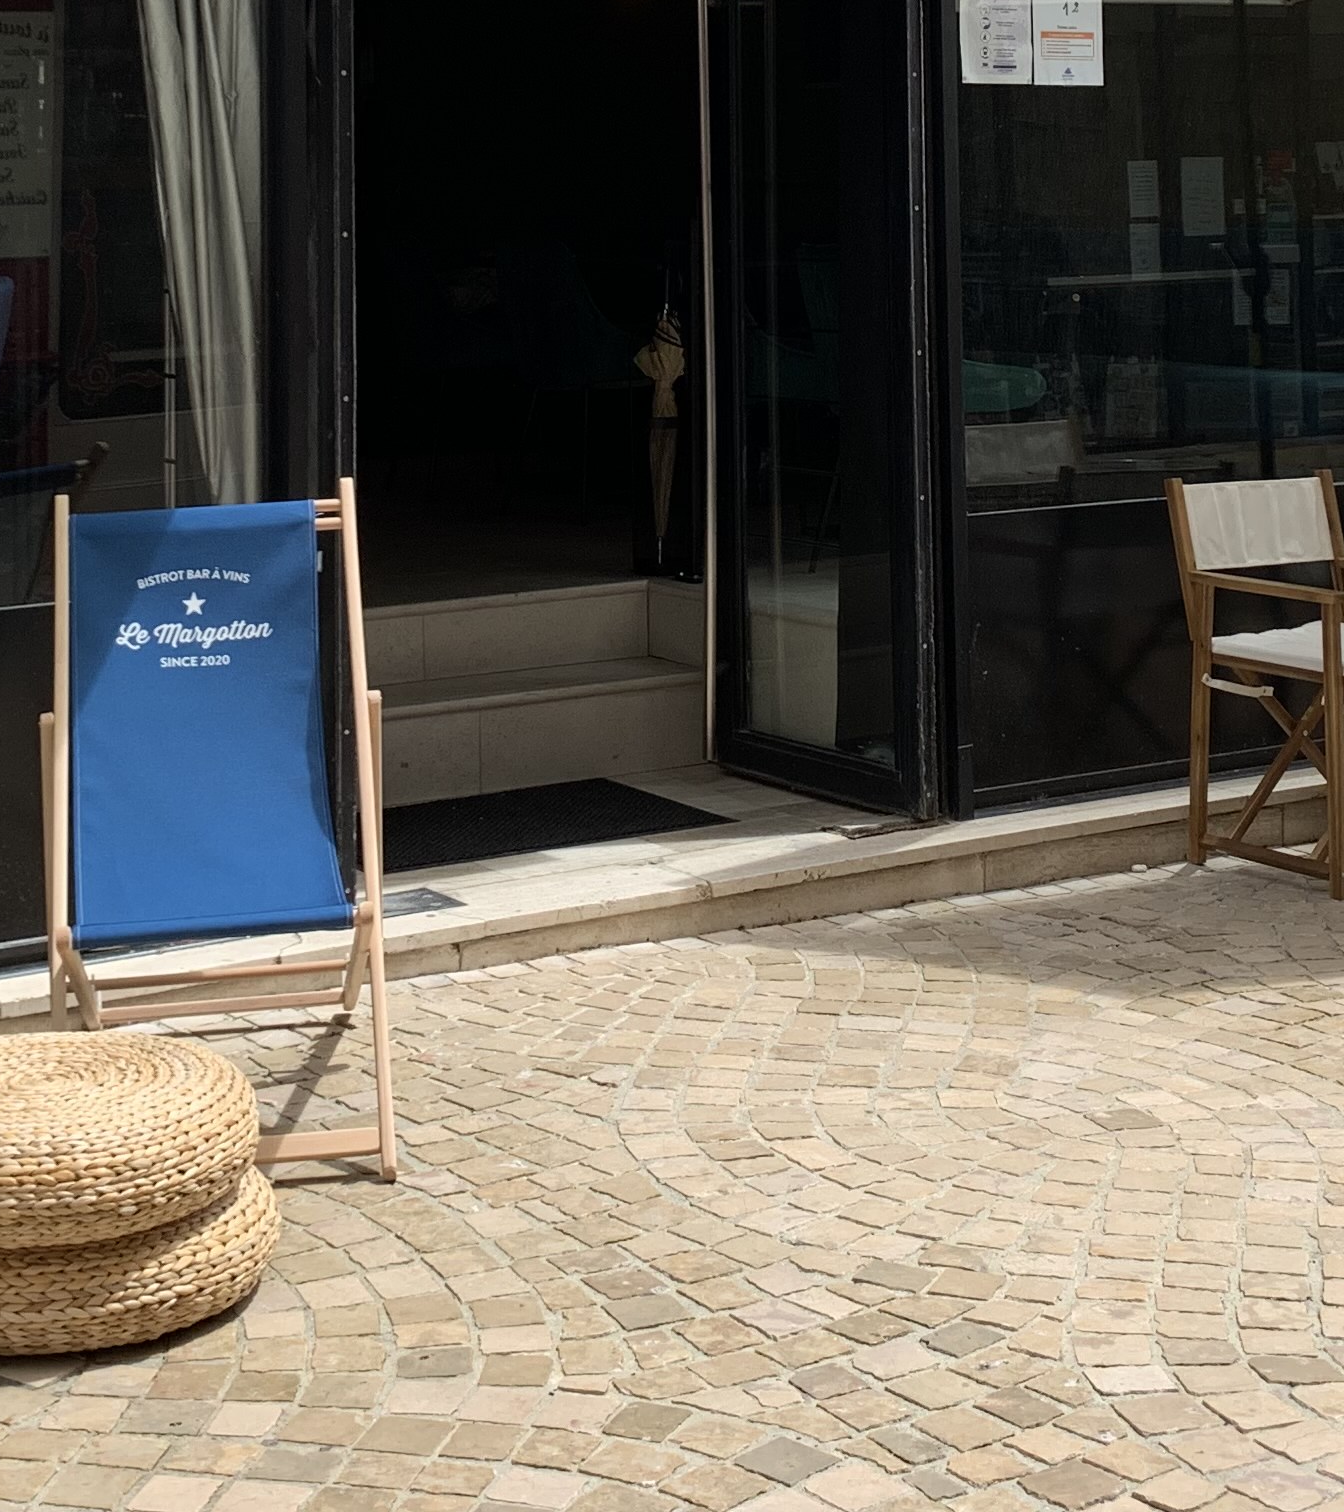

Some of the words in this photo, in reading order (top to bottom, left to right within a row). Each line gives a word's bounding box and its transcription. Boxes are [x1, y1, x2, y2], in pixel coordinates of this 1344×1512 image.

[136, 570, 185, 590] BISTROT
[186, 568, 210, 579] BAR
[211, 566, 221, 579] À
[222, 570, 252, 584] VINS
[116, 622, 151, 650] Le
[153, 619, 274, 649] Margotton
[159, 656, 199, 668] SINCE
[200, 655, 231, 667] 2020
